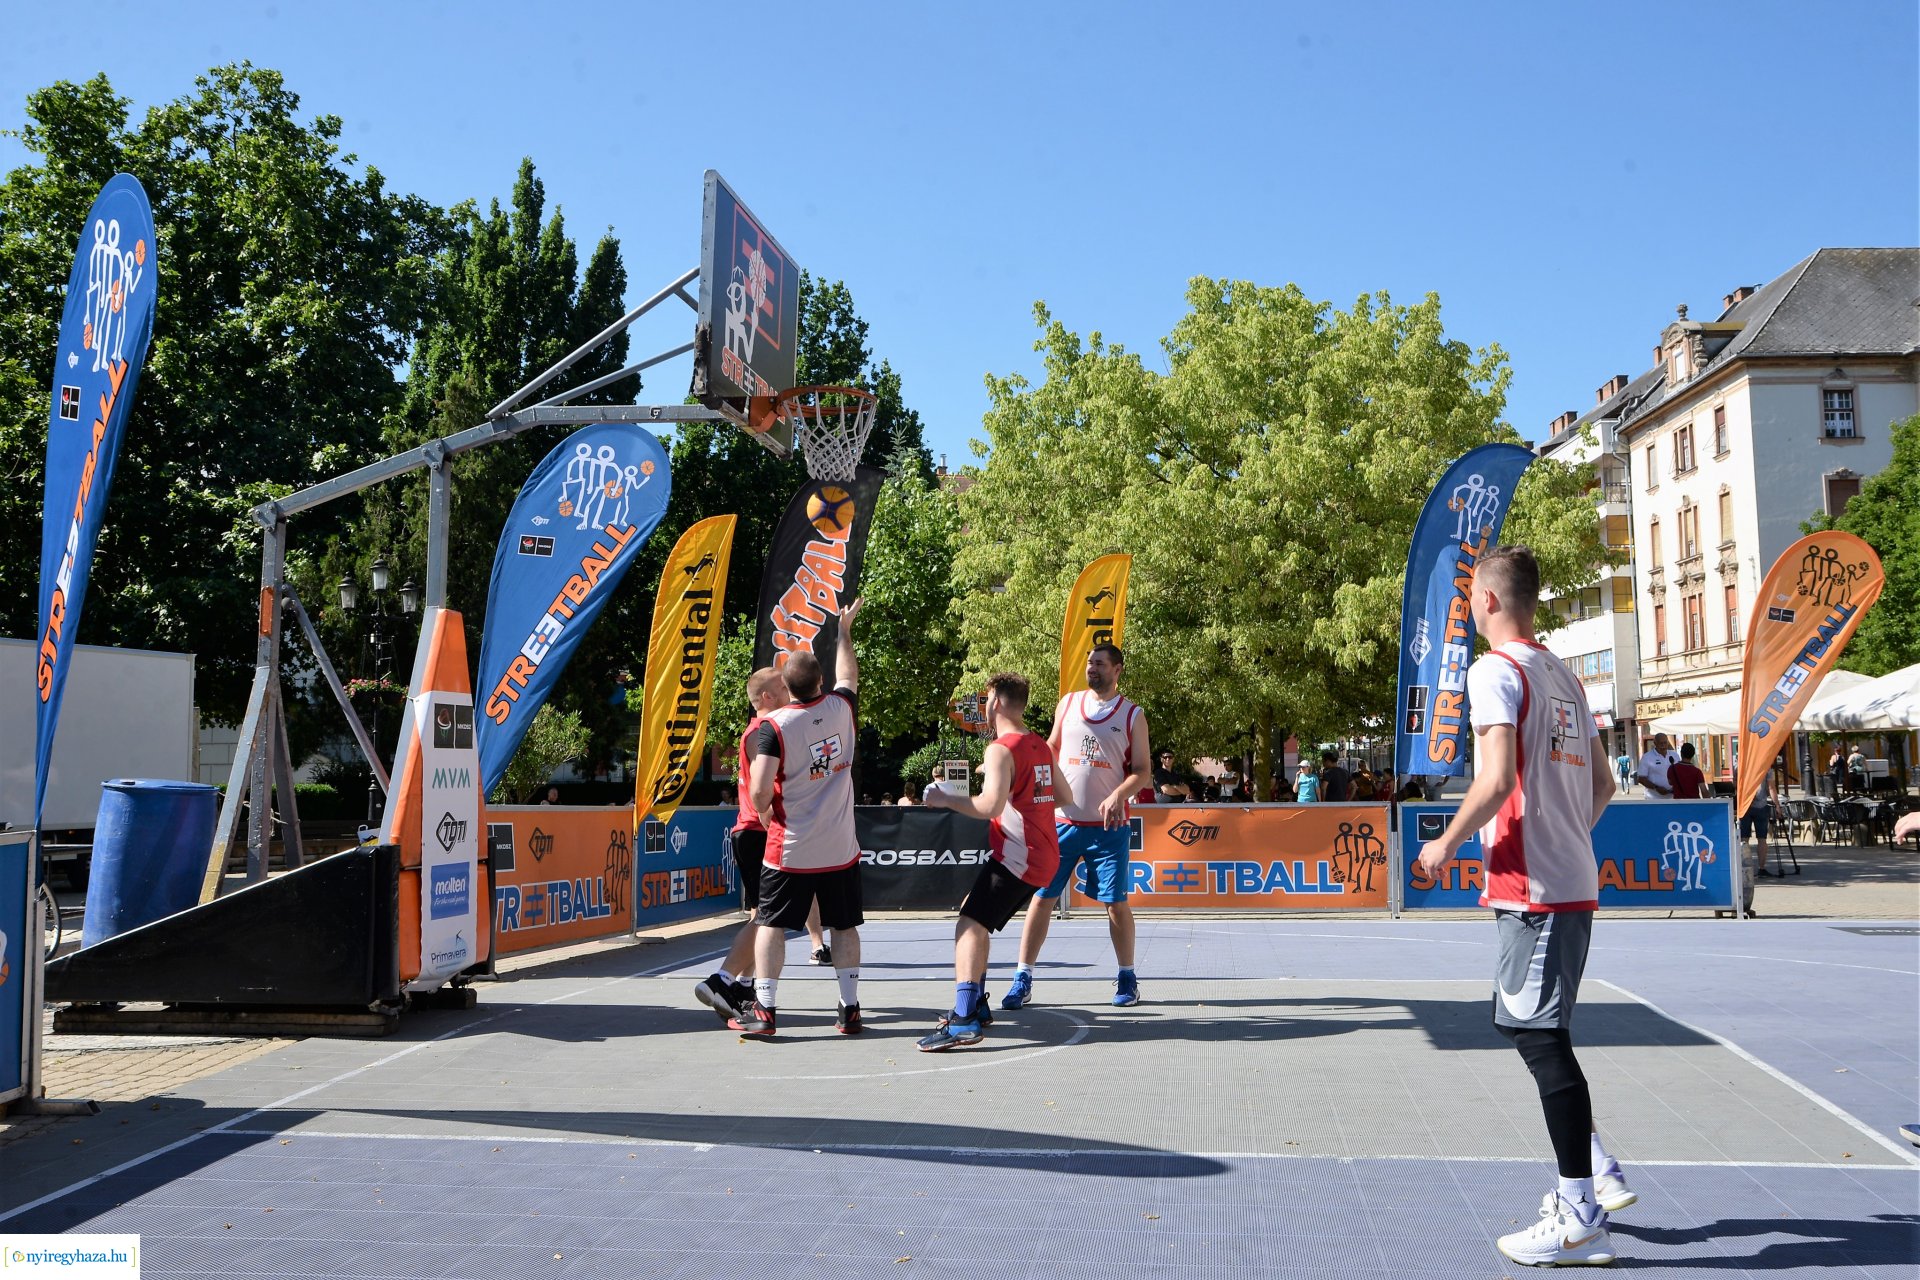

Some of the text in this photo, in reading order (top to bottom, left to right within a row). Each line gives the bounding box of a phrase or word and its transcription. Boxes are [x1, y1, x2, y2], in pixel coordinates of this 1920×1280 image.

[37, 358, 128, 703] STREETBALL
[485, 524, 638, 726] STREETBALL
[1428, 536, 1488, 764] STREETBALL
[1748, 601, 1858, 740] STREETBALL
[652, 587, 713, 806] Continental
[432, 767, 471, 789] MVM
[442, 820, 468, 843] TOTI
[1179, 826, 1220, 841] TOTI
[435, 877, 467, 896] molten
[641, 864, 727, 910] STREETBALL
[431, 947, 467, 965] Primavera
